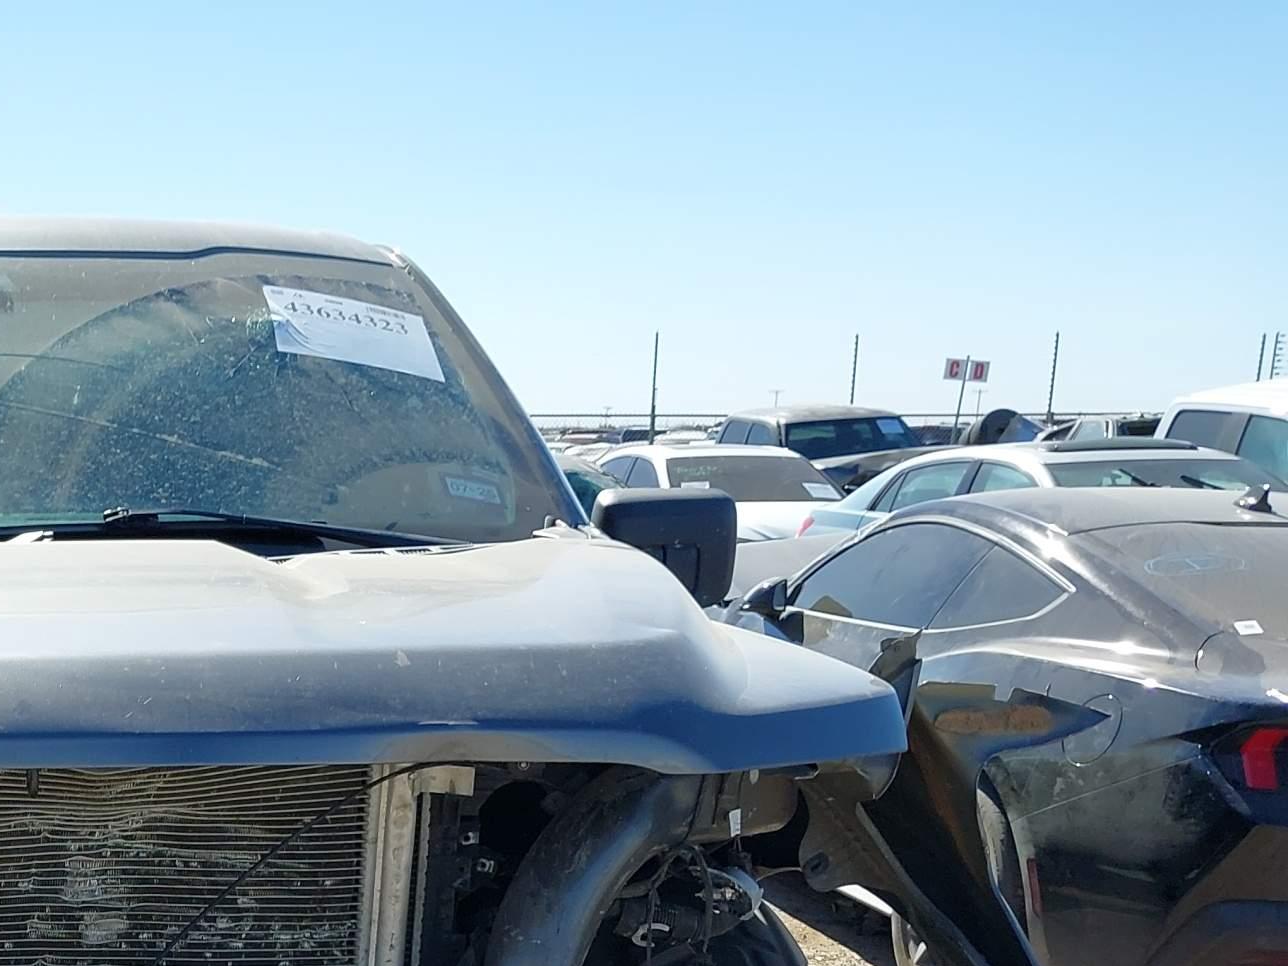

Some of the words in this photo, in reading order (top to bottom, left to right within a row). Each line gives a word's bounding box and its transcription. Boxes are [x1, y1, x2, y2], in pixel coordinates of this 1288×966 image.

[284, 301, 409, 335] 43634323
[949, 361, 960, 378] C
[973, 361, 985, 380] D
